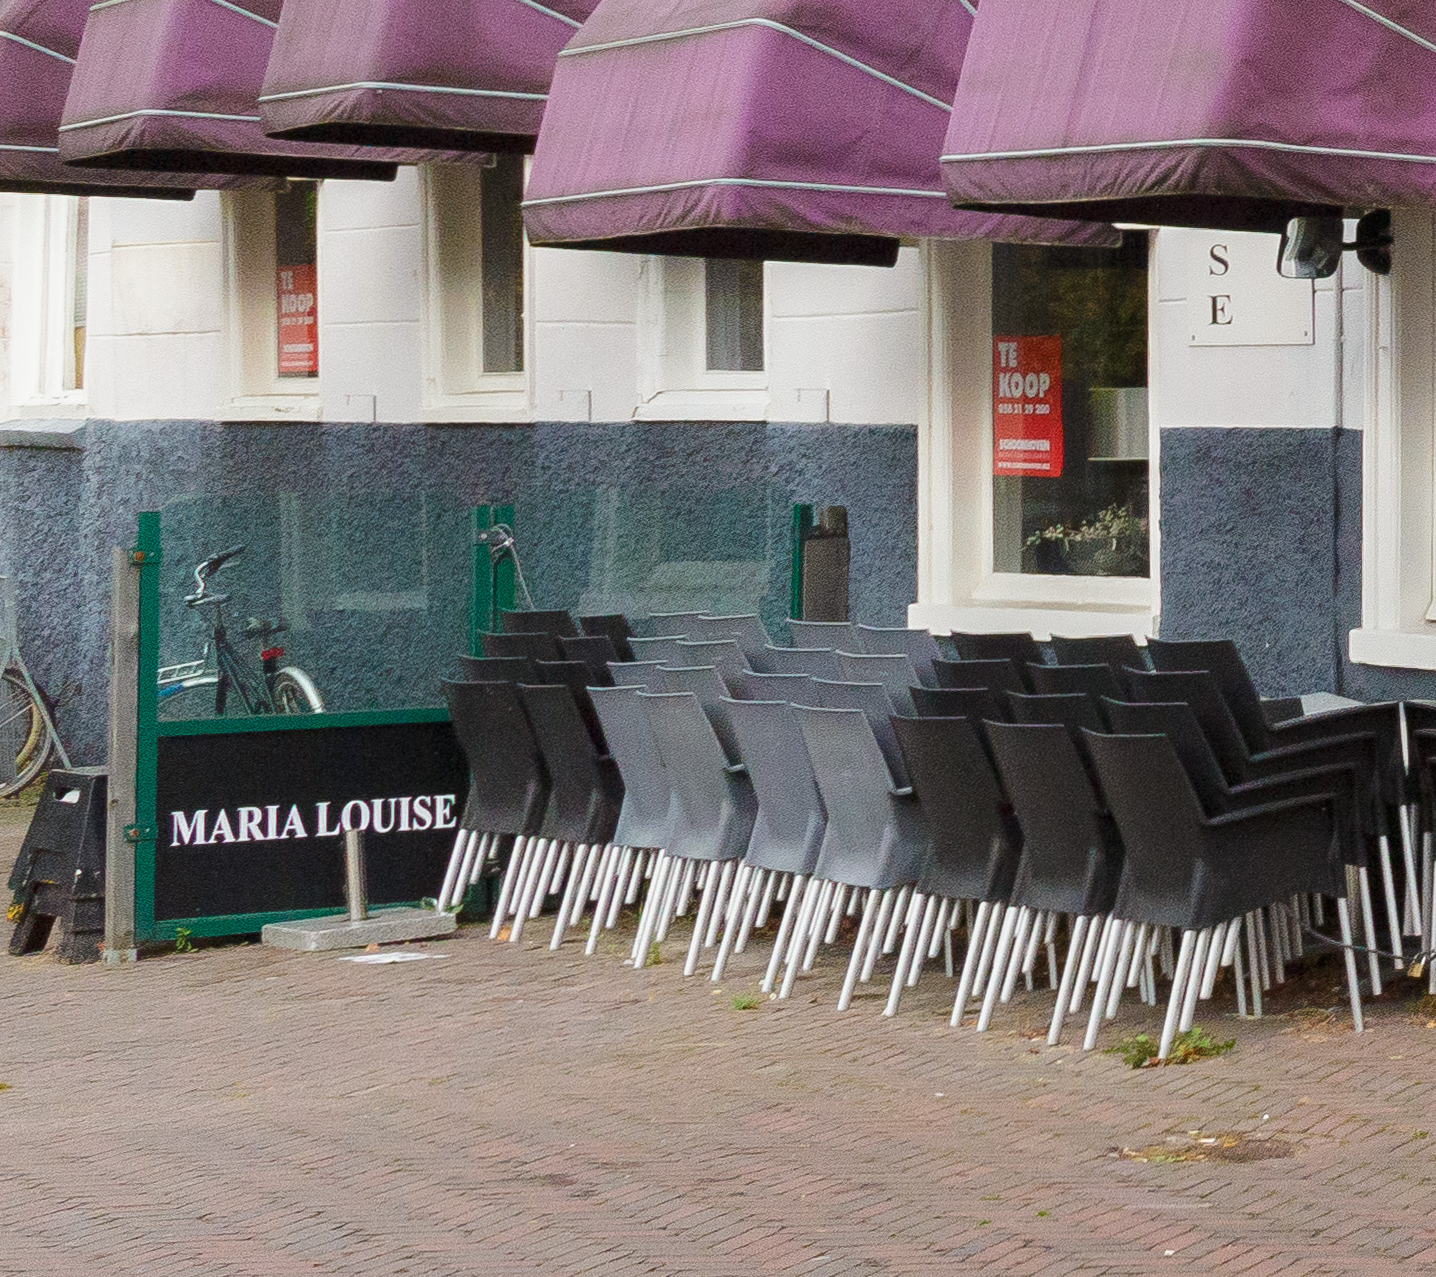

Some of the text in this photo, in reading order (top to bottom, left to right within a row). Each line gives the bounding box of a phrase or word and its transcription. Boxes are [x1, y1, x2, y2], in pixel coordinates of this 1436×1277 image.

[998, 342, 1018, 368] TE
[999, 372, 1050, 398] KOOP
[169, 793, 457, 847] MARIA LOUISE
